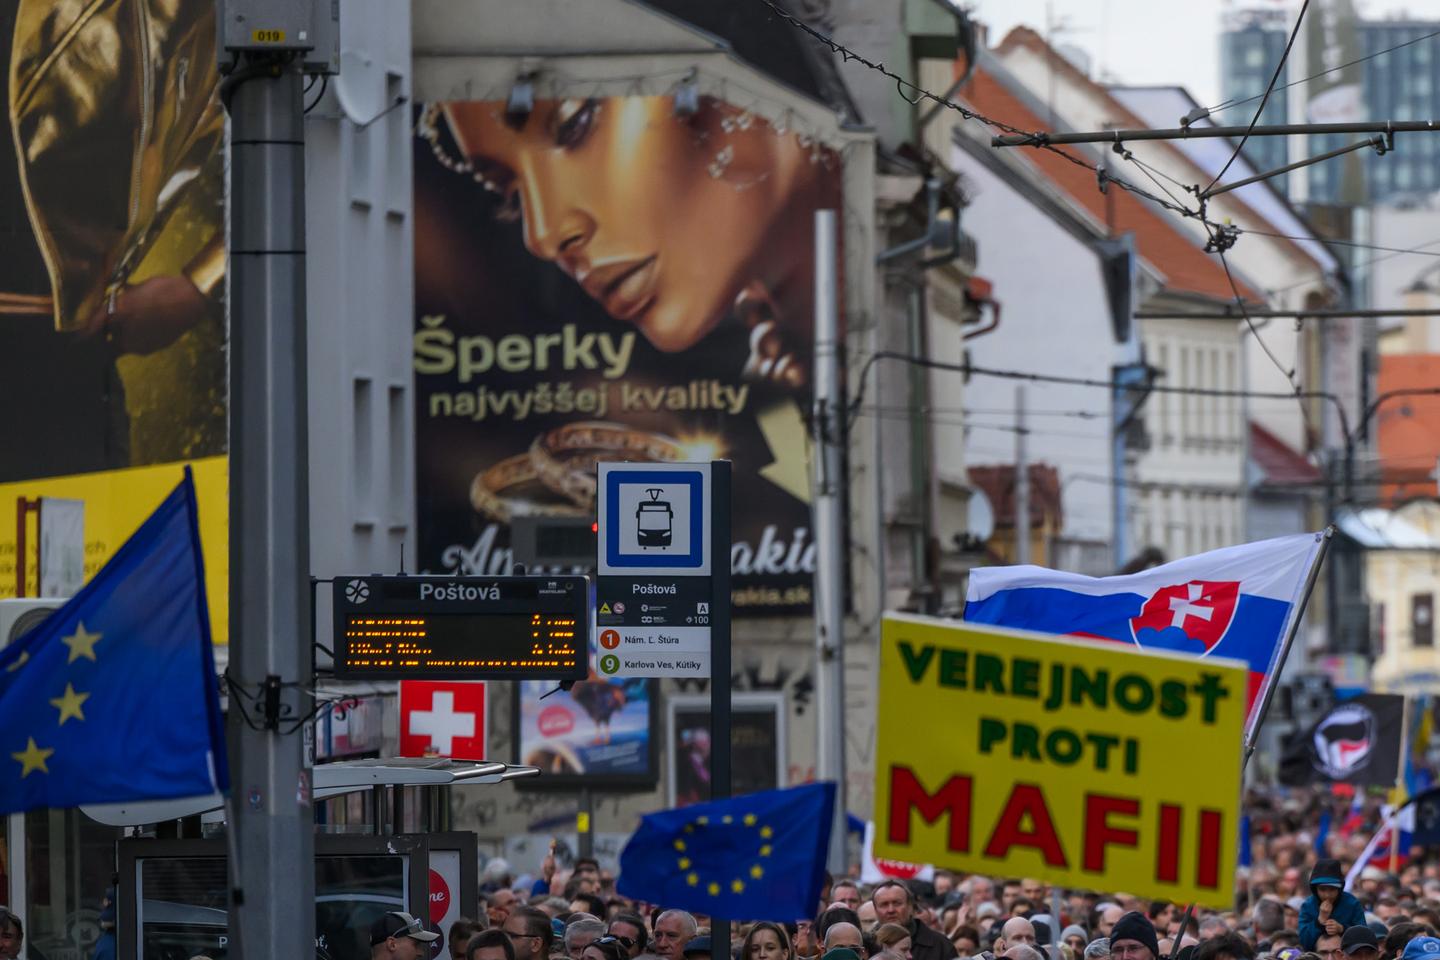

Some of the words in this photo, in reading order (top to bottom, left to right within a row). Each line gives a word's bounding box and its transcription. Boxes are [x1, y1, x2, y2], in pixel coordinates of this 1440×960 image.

[412, 315, 636, 380] Šperky
[429, 381, 608, 421] najvyššej
[621, 379, 750, 415] kvality
[420, 583, 501, 601] Poštová
[632, 584, 677, 594] Poštová
[698, 603, 708, 614] A
[694, 616, 709, 624] 100
[606, 633, 613, 646] 1
[624, 636, 646, 644] Nám.
[658, 635, 680, 644] Štúra
[605, 658, 615, 671] 9
[624, 661, 655, 669] Karlova
[656, 661, 674, 670] Ves,
[676, 660, 701, 671] Kútiky
[895, 640, 1230, 725] VEREJNOSŤ
[977, 715, 1140, 775] PROTI
[886, 763, 1223, 890] MAFII
